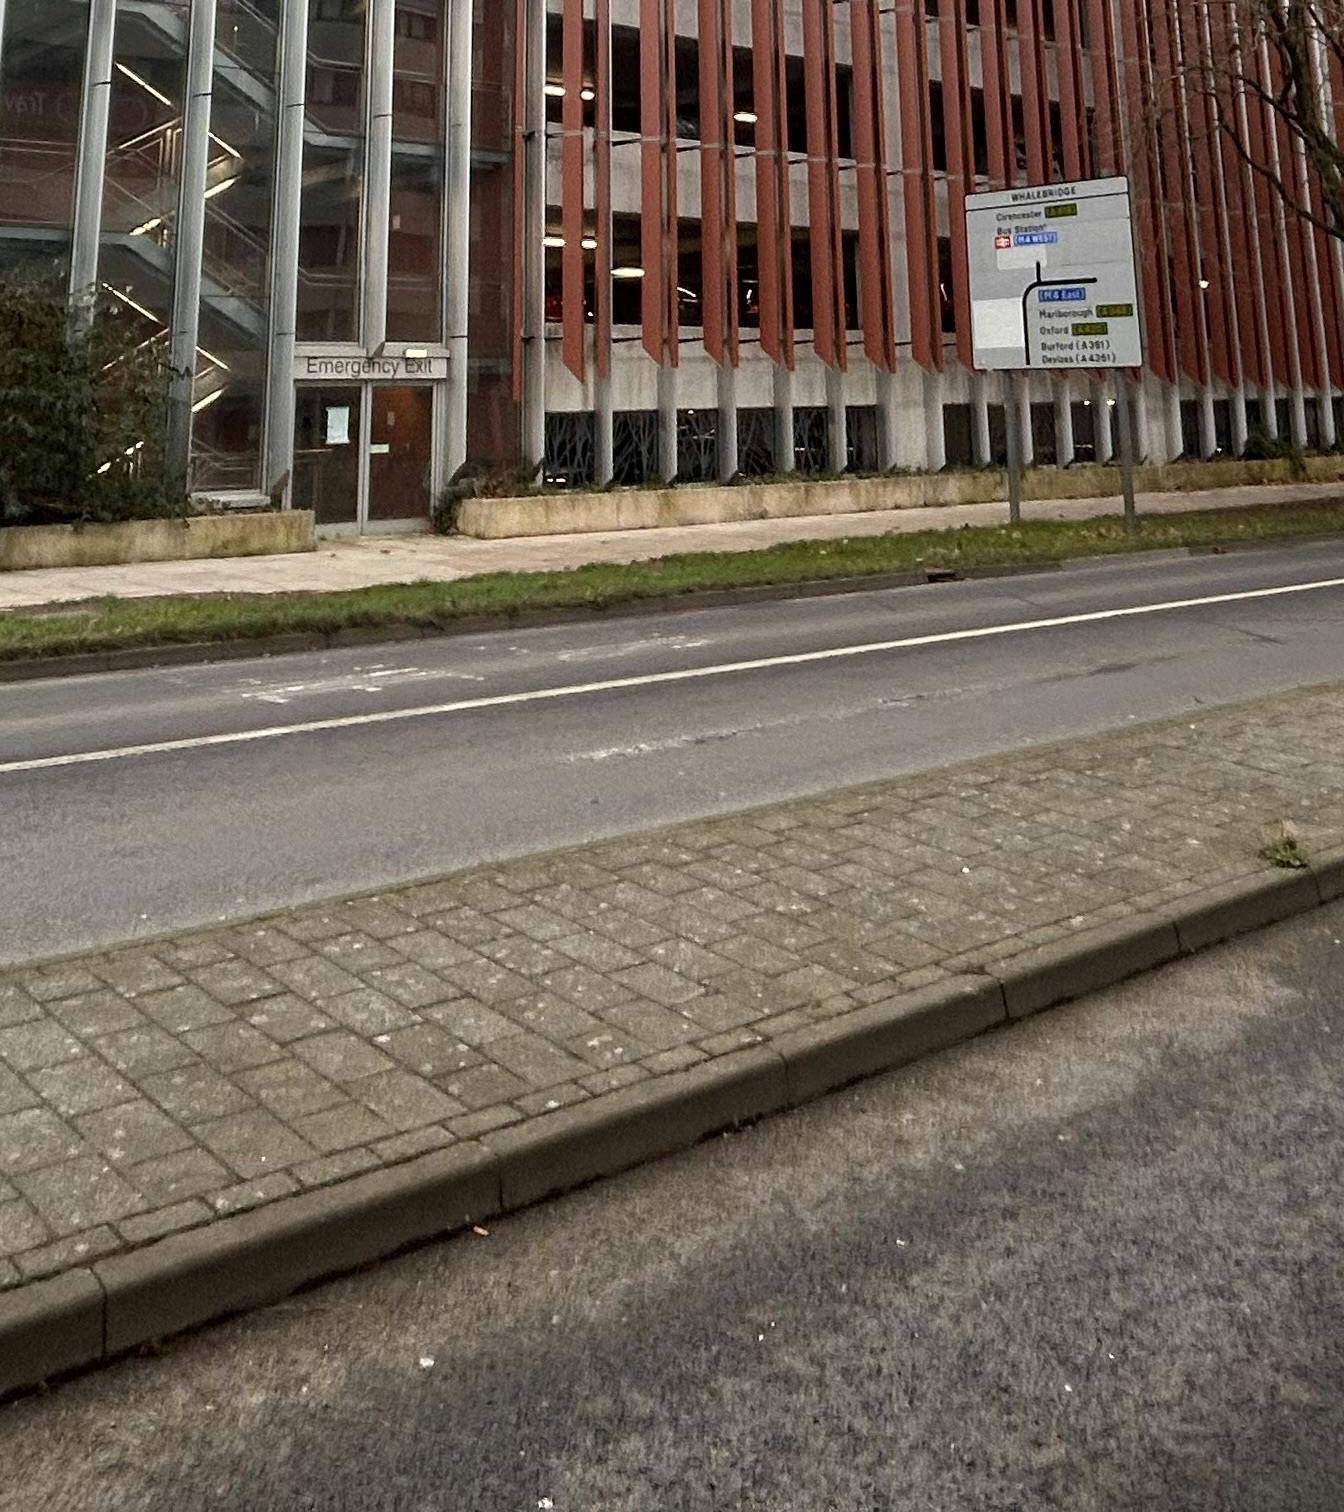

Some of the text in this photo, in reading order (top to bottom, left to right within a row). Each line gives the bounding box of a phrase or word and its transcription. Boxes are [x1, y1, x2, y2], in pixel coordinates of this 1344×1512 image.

[1011, 186, 1077, 202] WHALEBRIDGE
[997, 226, 1012, 236] Bus
[1039, 326, 1069, 336] Oxford
[1041, 341, 1074, 351] Burford
[307, 357, 433, 378] Emergency Exit
